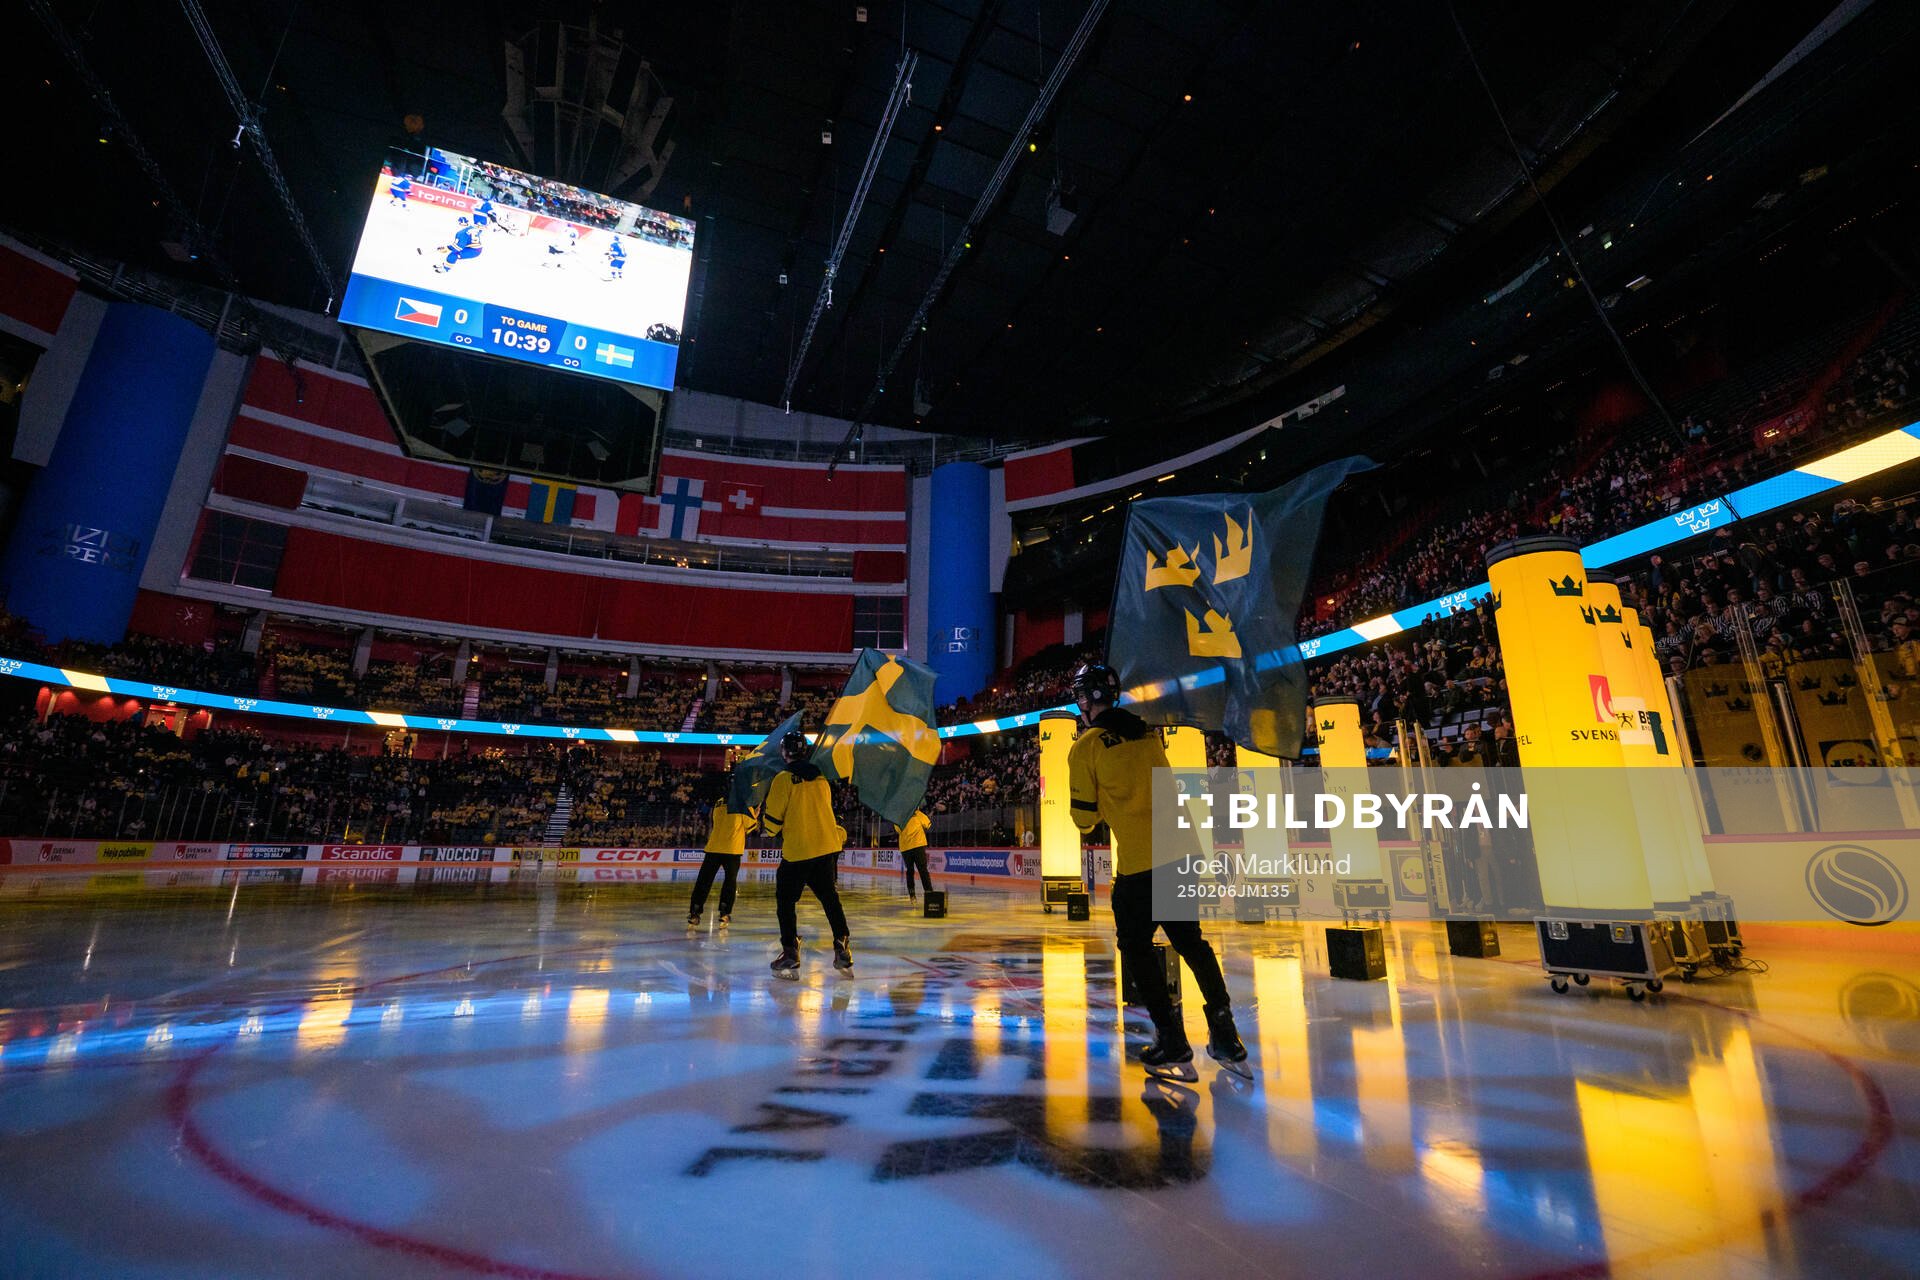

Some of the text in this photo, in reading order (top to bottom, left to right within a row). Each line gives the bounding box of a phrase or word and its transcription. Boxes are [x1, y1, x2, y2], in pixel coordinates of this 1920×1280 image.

[417, 189, 467, 209] torino
[454, 309, 468, 325] 0
[501, 315, 548, 333] TO GAME
[491, 328, 551, 353] 10:39
[574, 335, 588, 351] 0
[330, 847, 393, 860] Scandic
[436, 848, 479, 861] NOCCO
[595, 850, 661, 861] CCM
